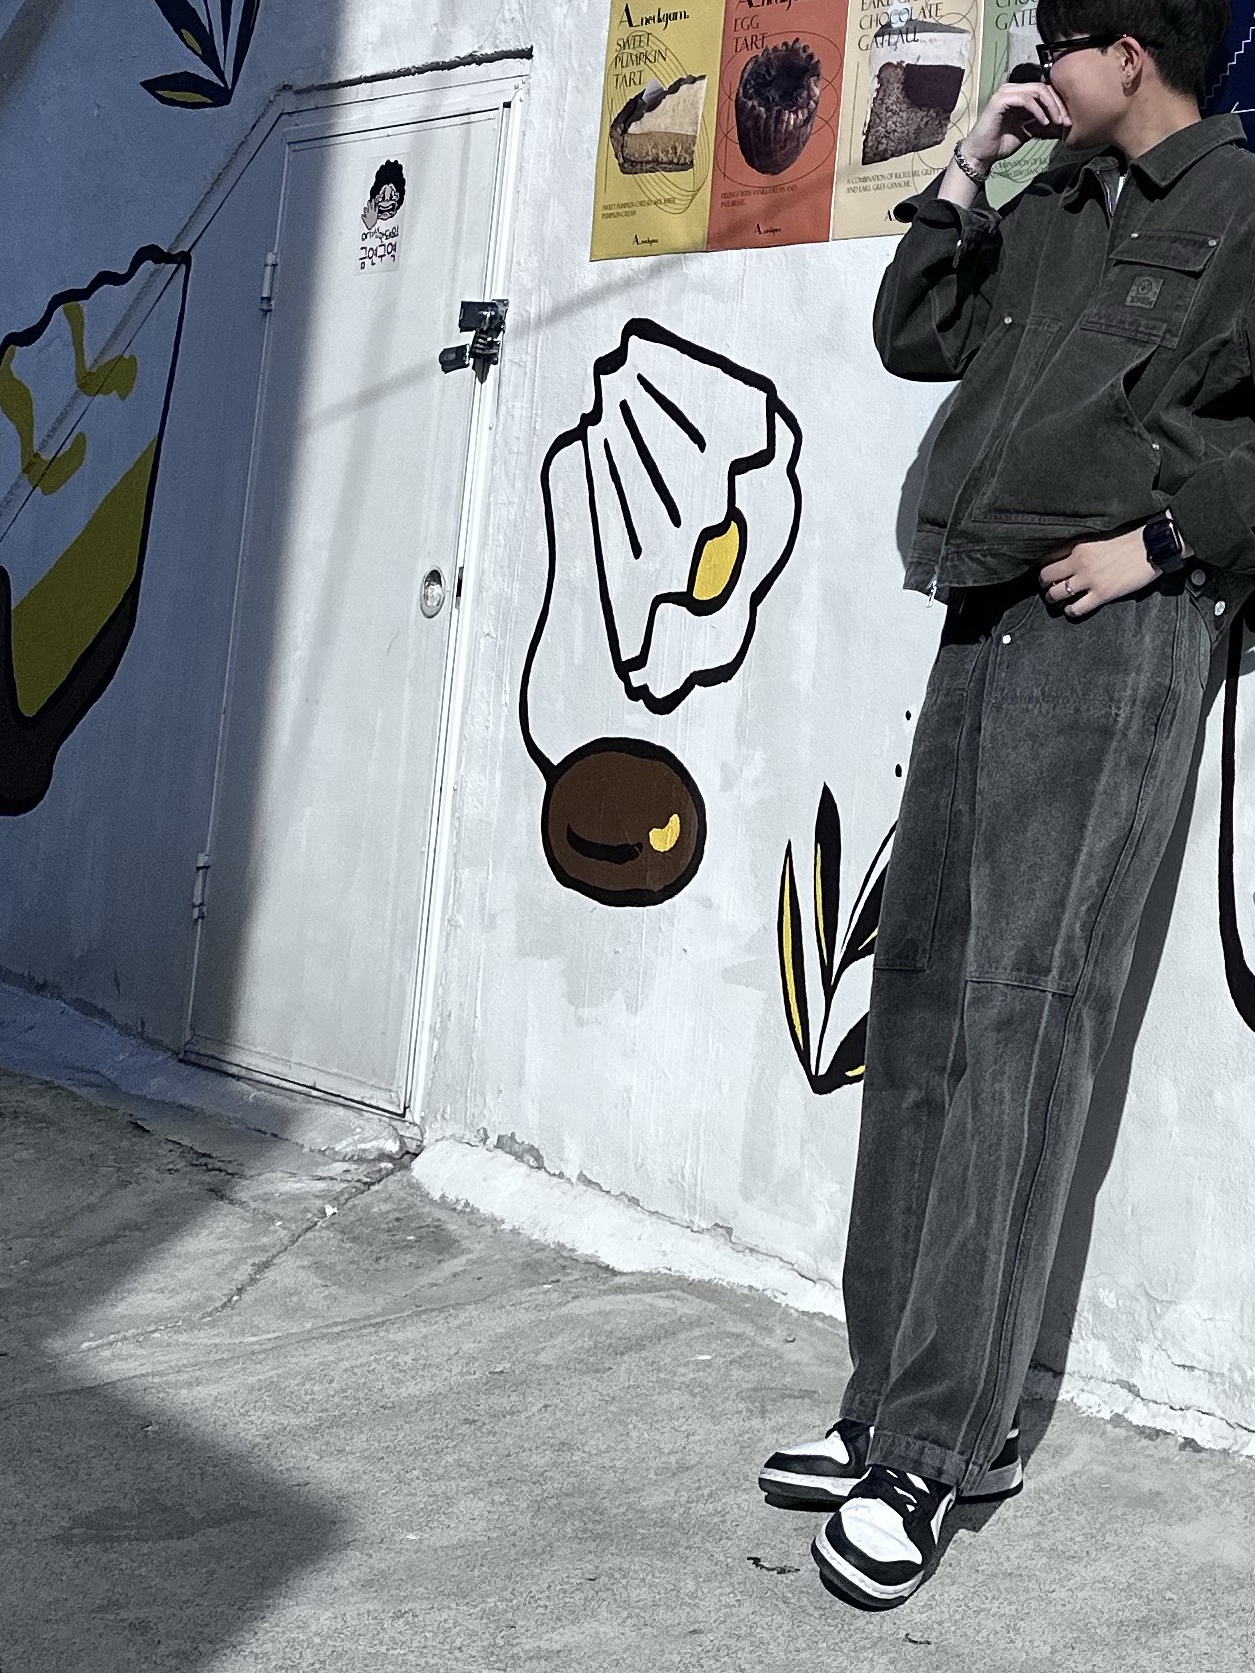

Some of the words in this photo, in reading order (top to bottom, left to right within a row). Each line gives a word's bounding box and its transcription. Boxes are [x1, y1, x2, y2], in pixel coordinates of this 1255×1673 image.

[733, 14, 759, 32] EGG
[859, 2, 944, 31] CHOCOLATE
[615, 32, 652, 52] SWEET
[614, 46, 669, 69] PUMPKIN
[358, 241, 398, 270] 금연구역
